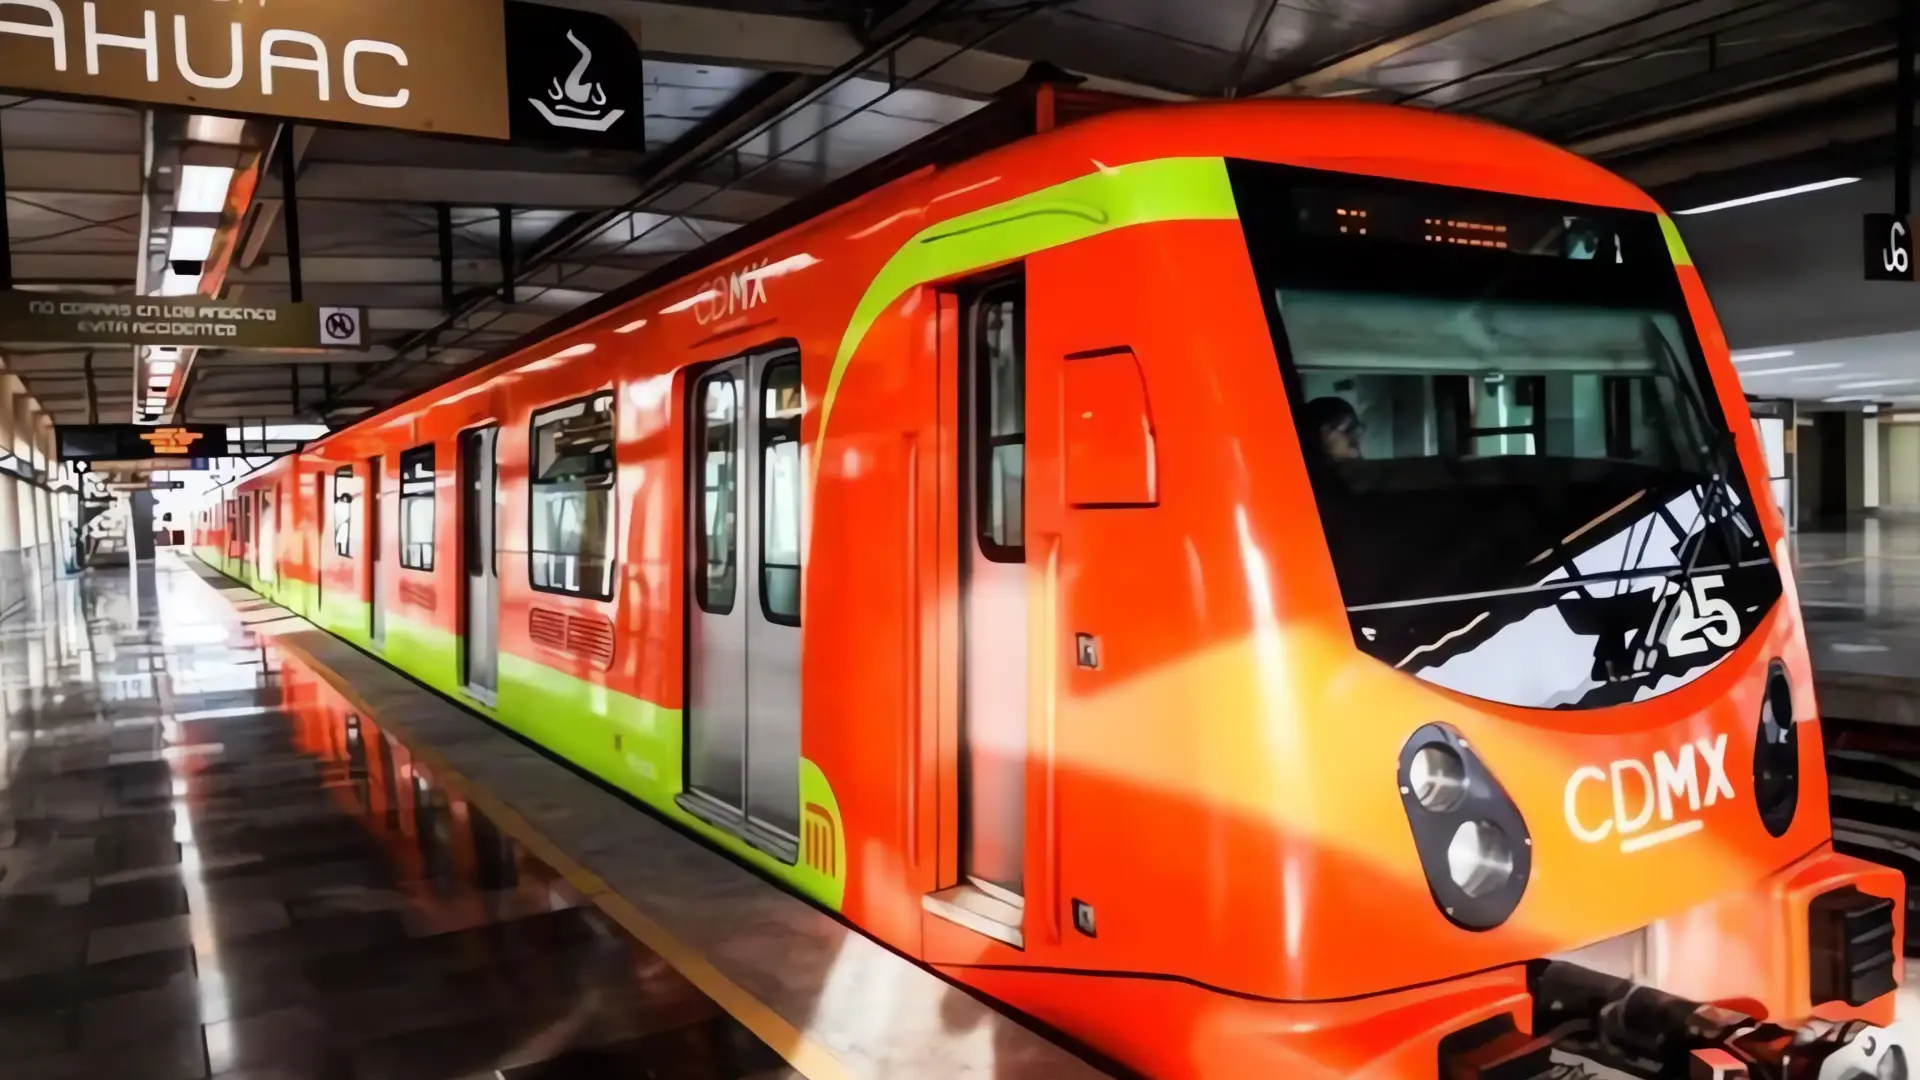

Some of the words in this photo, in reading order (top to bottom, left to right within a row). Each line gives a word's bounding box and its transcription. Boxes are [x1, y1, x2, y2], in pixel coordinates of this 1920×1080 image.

[694, 257, 768, 325] CDMX
[1656, 574, 1742, 658] 25
[1563, 733, 1735, 843] CDMX
